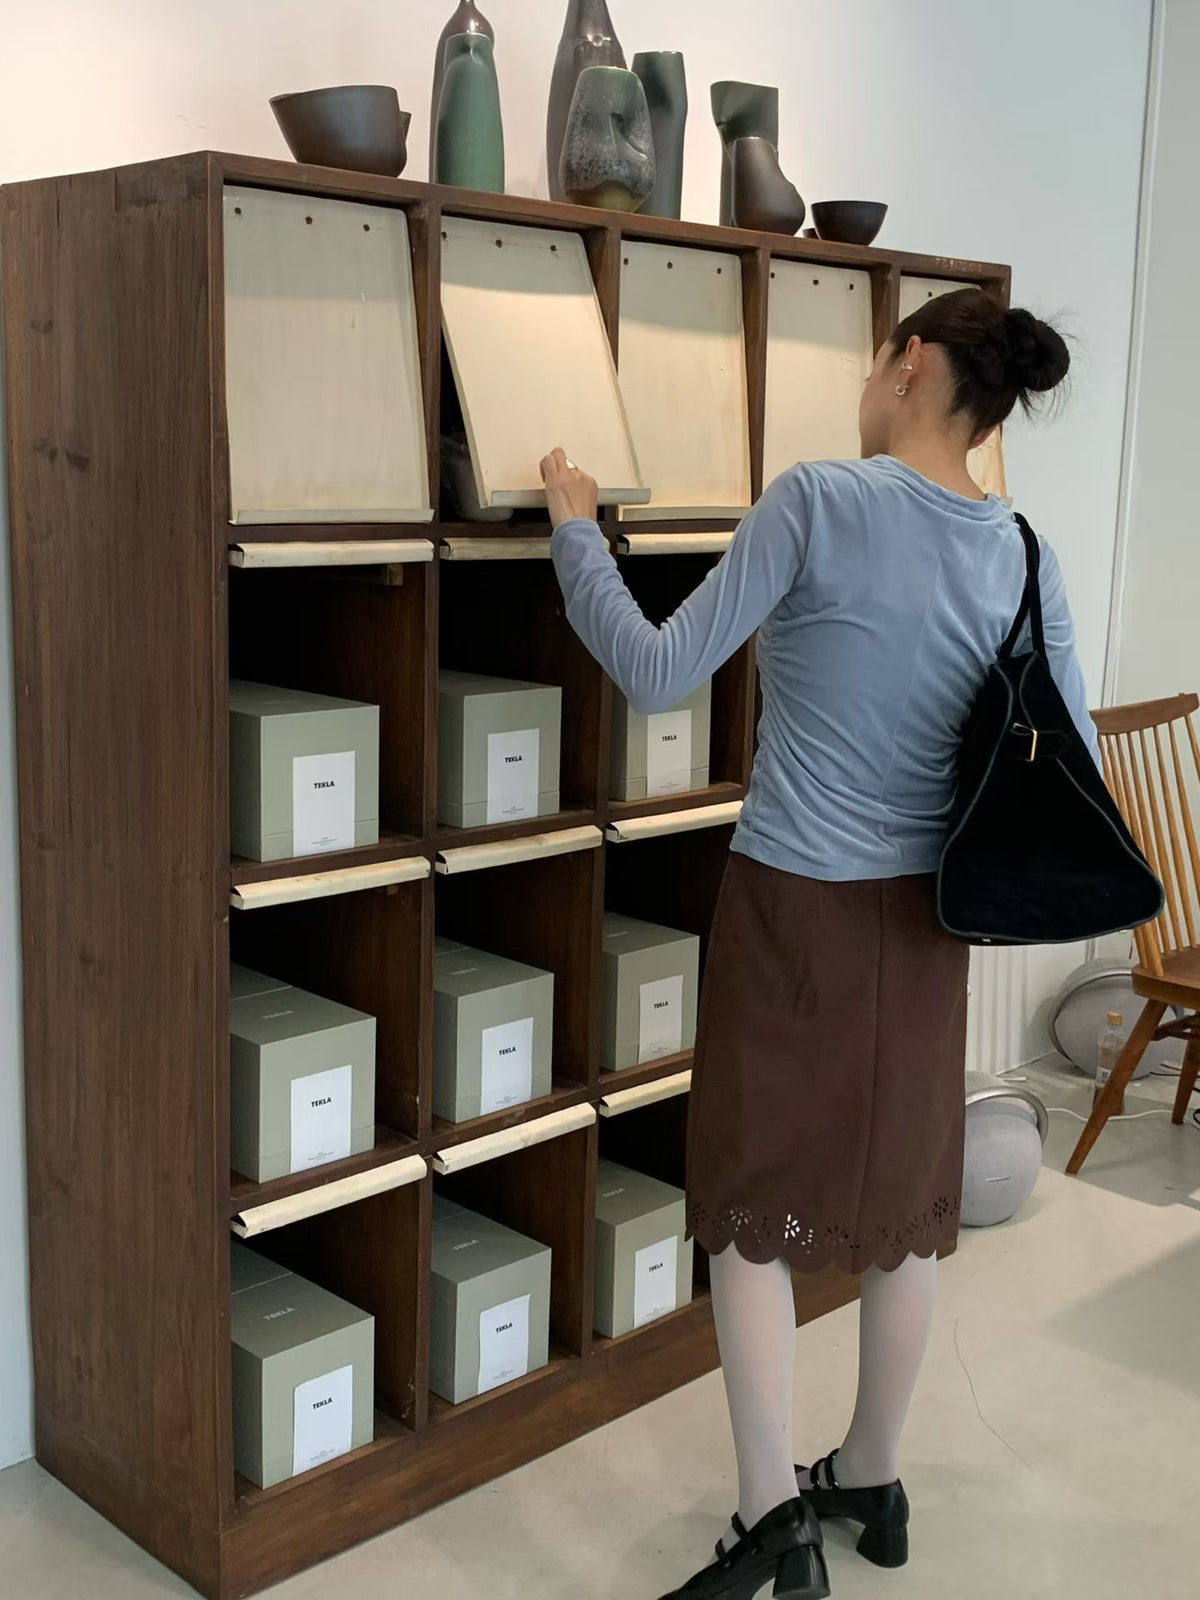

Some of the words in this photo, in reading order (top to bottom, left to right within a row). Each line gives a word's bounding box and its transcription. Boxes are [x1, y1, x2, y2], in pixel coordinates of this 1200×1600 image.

[661, 734, 678, 742] TEKLA
[504, 755, 523, 764] TEKLA
[313, 780, 336, 790] TEKLA
[653, 1000, 669, 1009] TEKLA
[498, 1046, 517, 1056] TEKLA
[310, 1096, 332, 1108] TEKLA
[648, 1262, 664, 1272] TEKLA
[262, 1307, 297, 1321] TEKLA
[495, 1322, 513, 1334] TEKLA
[312, 1397, 333, 1410] TEKLA
